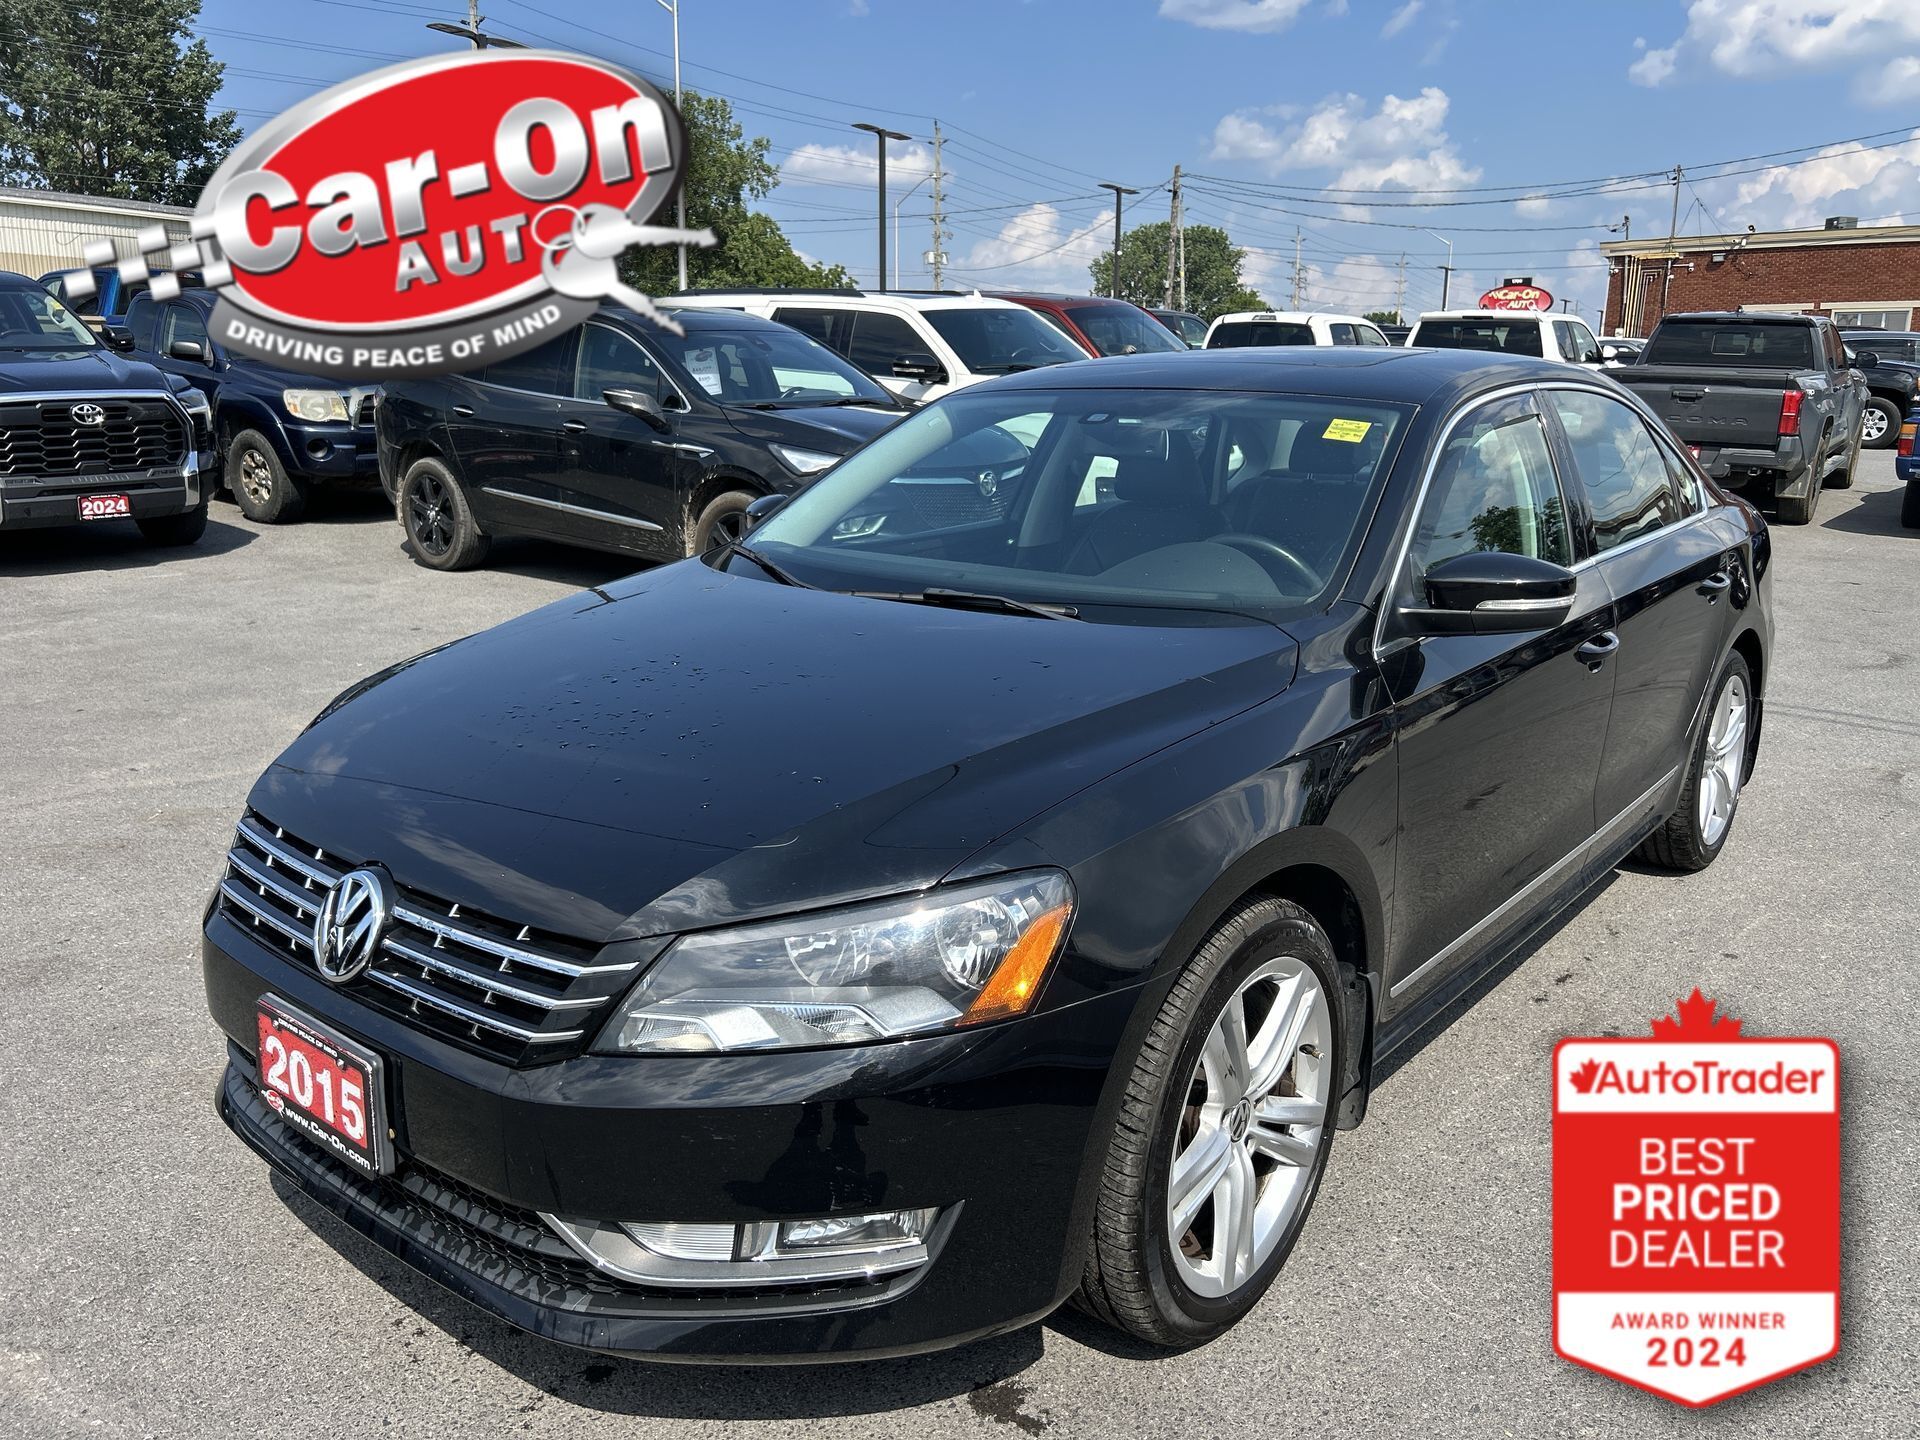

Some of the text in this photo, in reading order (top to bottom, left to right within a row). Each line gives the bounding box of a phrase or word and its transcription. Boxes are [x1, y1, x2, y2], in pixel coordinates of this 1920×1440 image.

[1500, 289, 1540, 300] Car-On
[1665, 415, 1749, 426] COMA
[82, 499, 127, 515] 2024
[265, 1036, 365, 1140] 2015
[285, 1106, 371, 1170] www.Car-On.com
